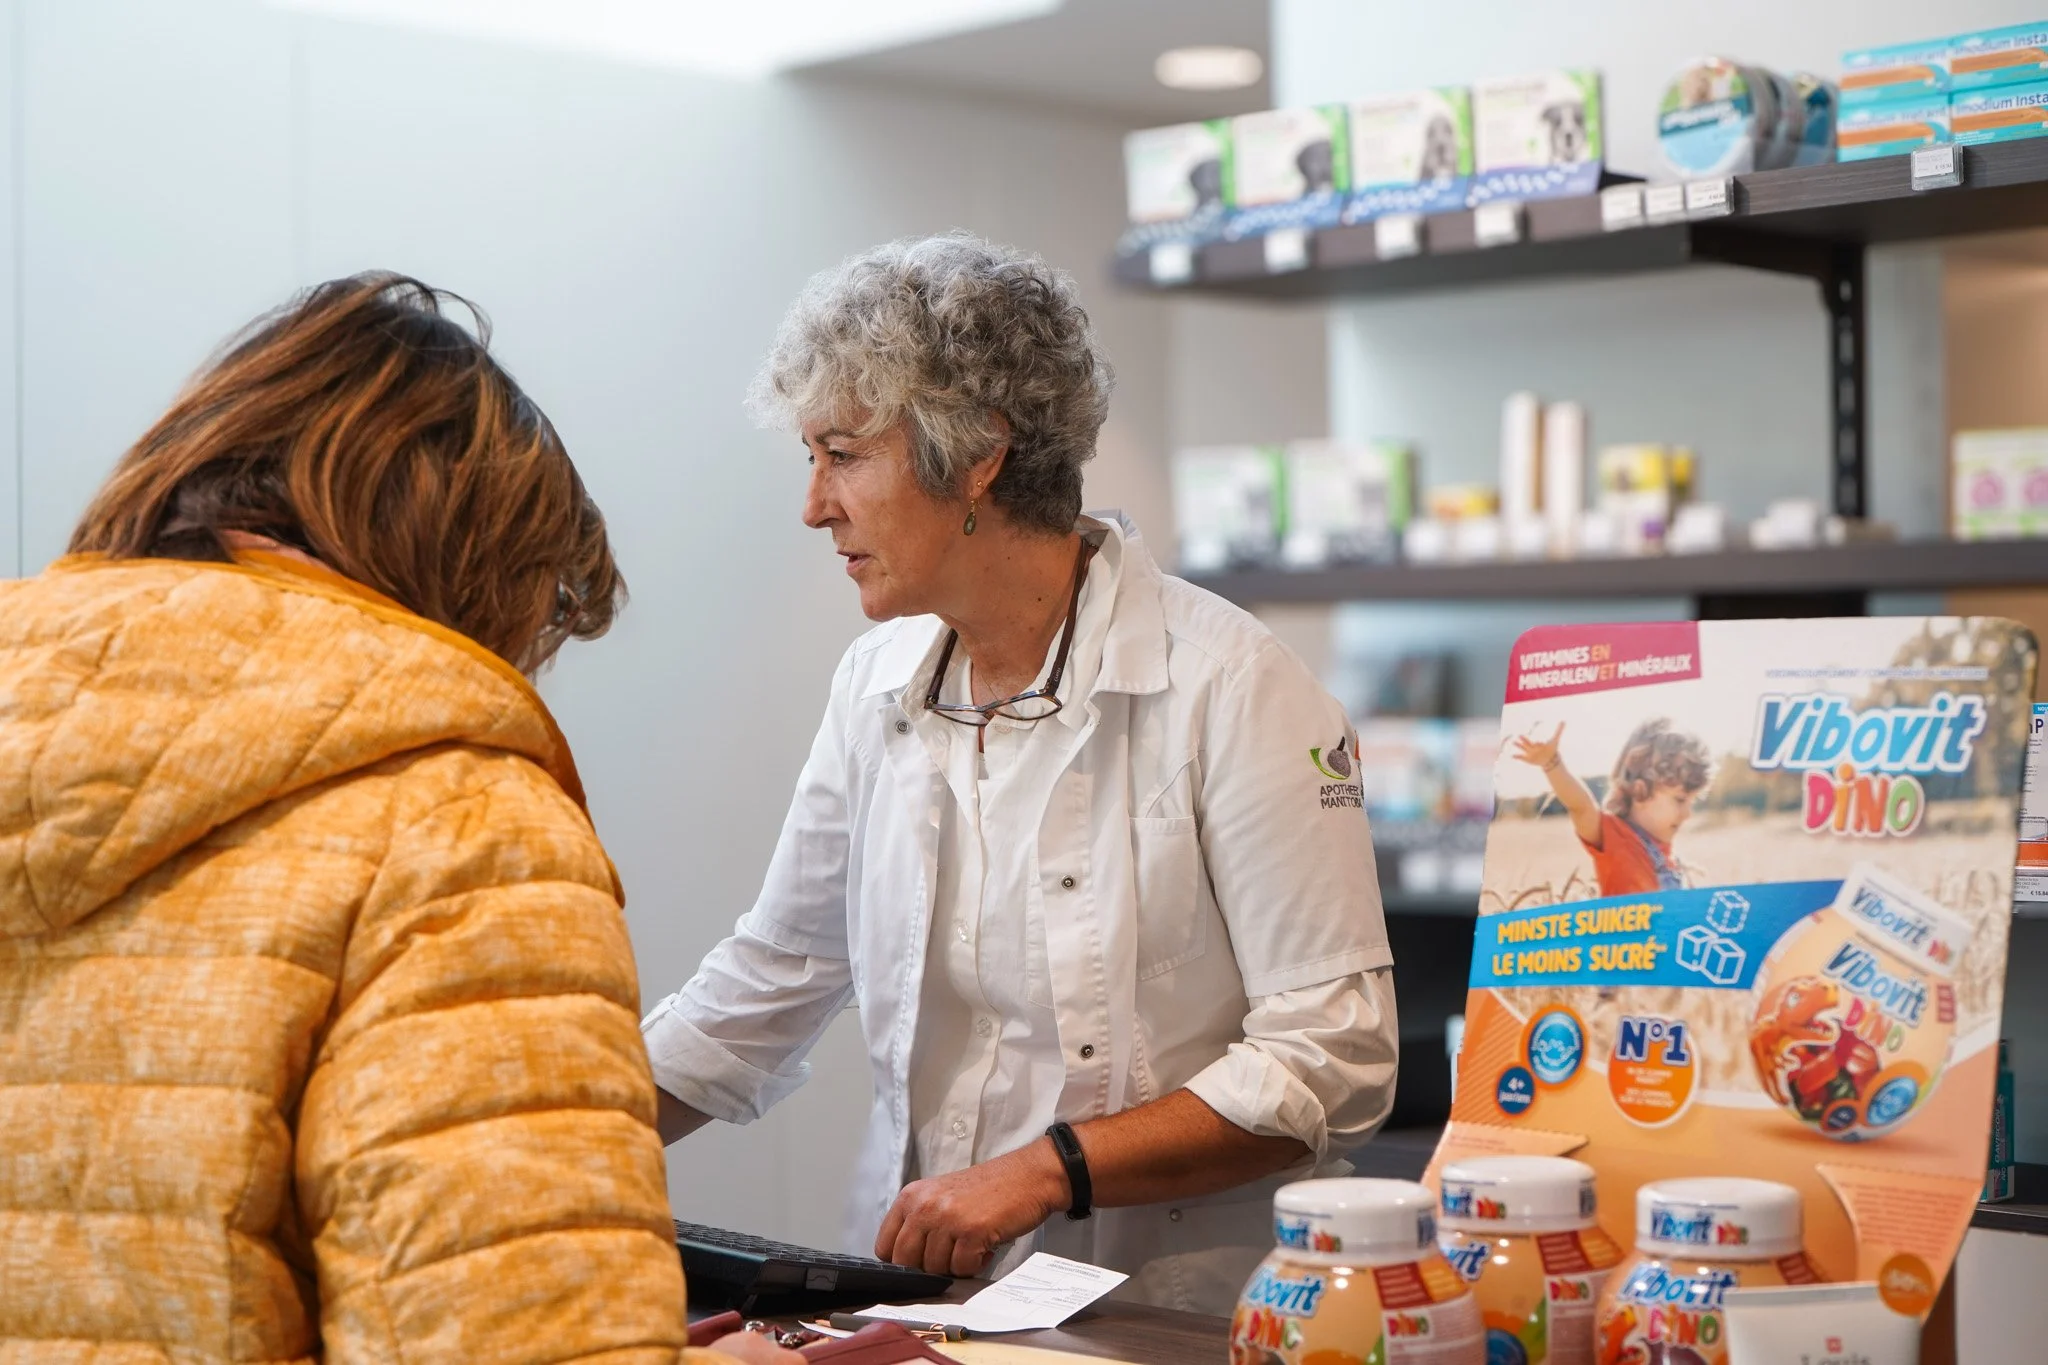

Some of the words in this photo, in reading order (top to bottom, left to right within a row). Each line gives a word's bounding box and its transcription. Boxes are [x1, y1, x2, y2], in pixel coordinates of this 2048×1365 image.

[2015, 92, 2048, 107] Insta
[1518, 665, 1599, 691] MINERALEN
[1599, 663, 1617, 681] ET
[1617, 654, 1692, 679] MINÉRAUX
[1520, 646, 1590, 671] VITAMINES
[1591, 644, 1612, 662] EN
[1756, 697, 1980, 765] Vibovit
[1497, 912, 1571, 944] MINSTE
[1851, 887, 1929, 945] Vibovit
[1492, 952, 1514, 976] LE
[1517, 946, 1582, 974] MOINS
[1826, 943, 1926, 1021] Vibovit
